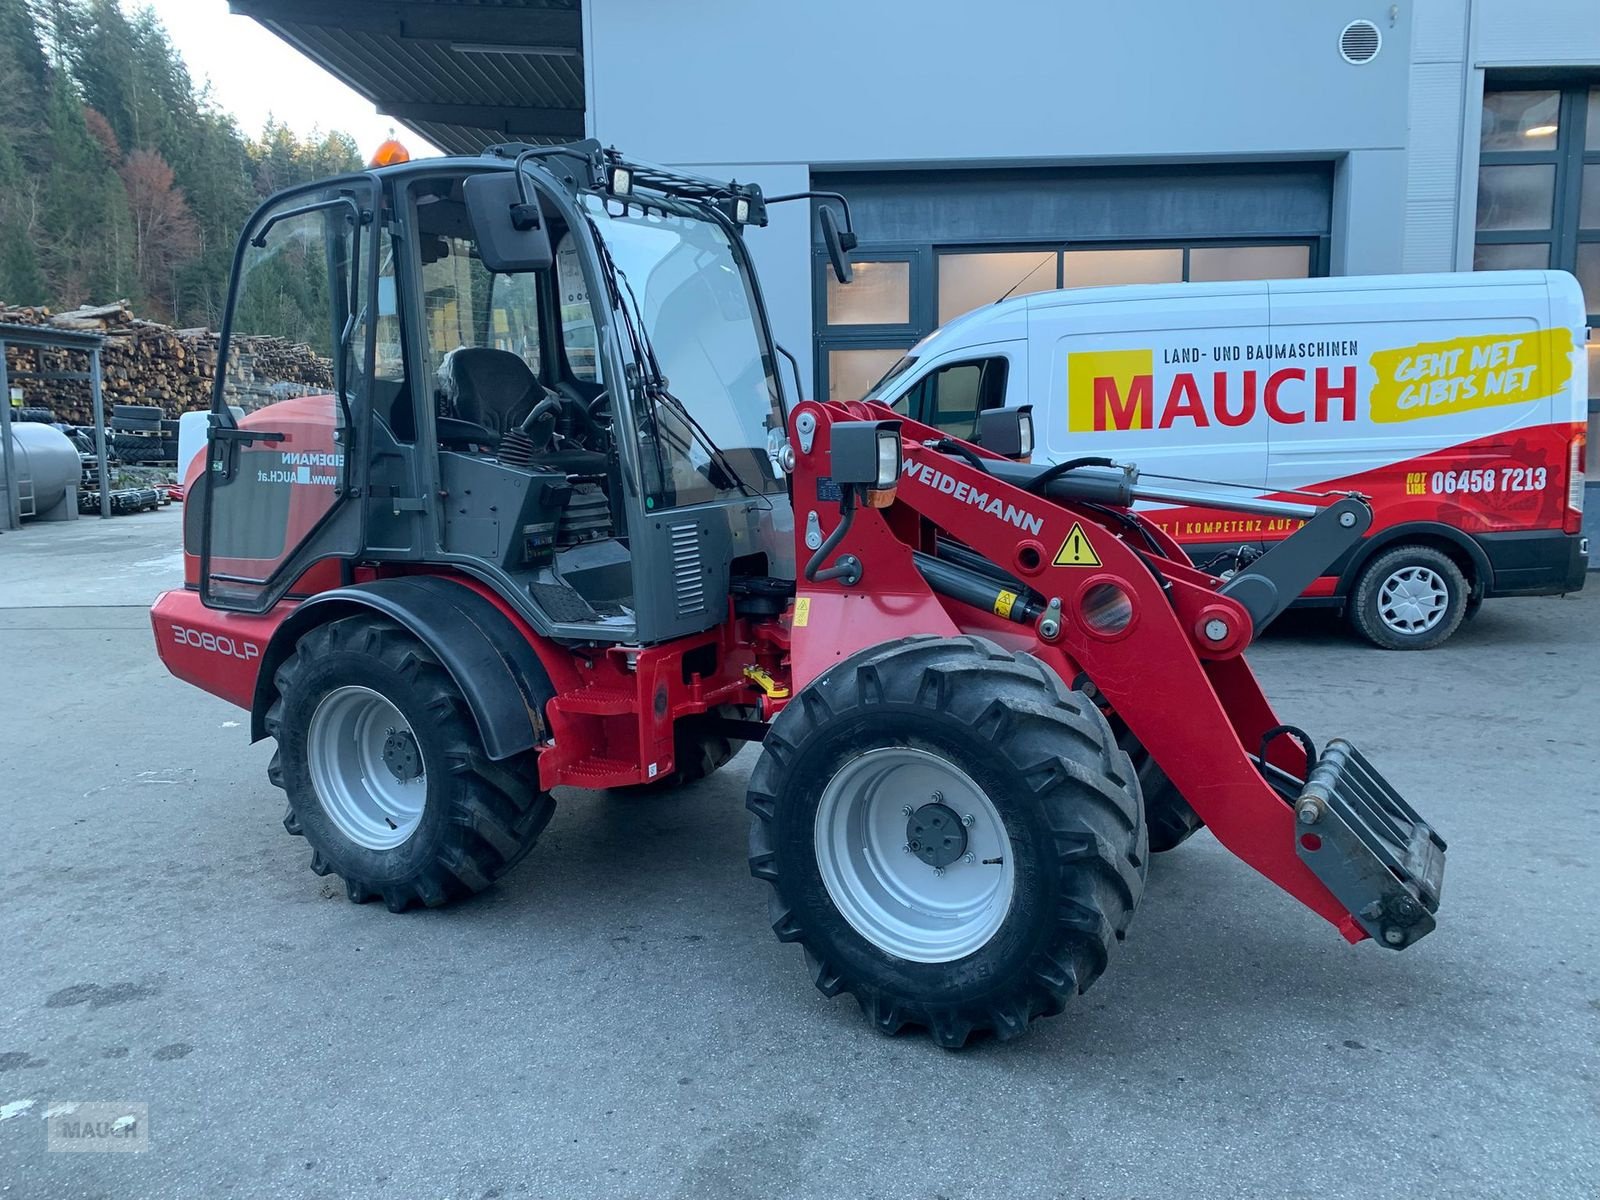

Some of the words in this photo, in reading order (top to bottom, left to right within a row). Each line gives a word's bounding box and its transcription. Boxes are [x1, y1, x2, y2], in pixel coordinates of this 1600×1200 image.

[1164, 348, 1207, 364] LAND-
[1213, 348, 1240, 362] UND
[1246, 340, 1358, 360] BAUMASCHINEN
[1394, 349, 1464, 382] GEHT
[1470, 339, 1523, 371] NET
[1093, 366, 1357, 432] MAUCH
[1397, 375, 1478, 410] GIBTS
[1484, 365, 1537, 397] NET
[1406, 472, 1427, 484] HOT
[1406, 483, 1426, 495] LINE
[1431, 469, 1495, 494] 06458
[1501, 467, 1547, 491] 7213
[902, 457, 1044, 536] WEIDEMANN
[1186, 520, 1261, 534] KOMPETENZ
[1268, 519, 1291, 531] AUF
[171, 624, 259, 660] 3080LP
